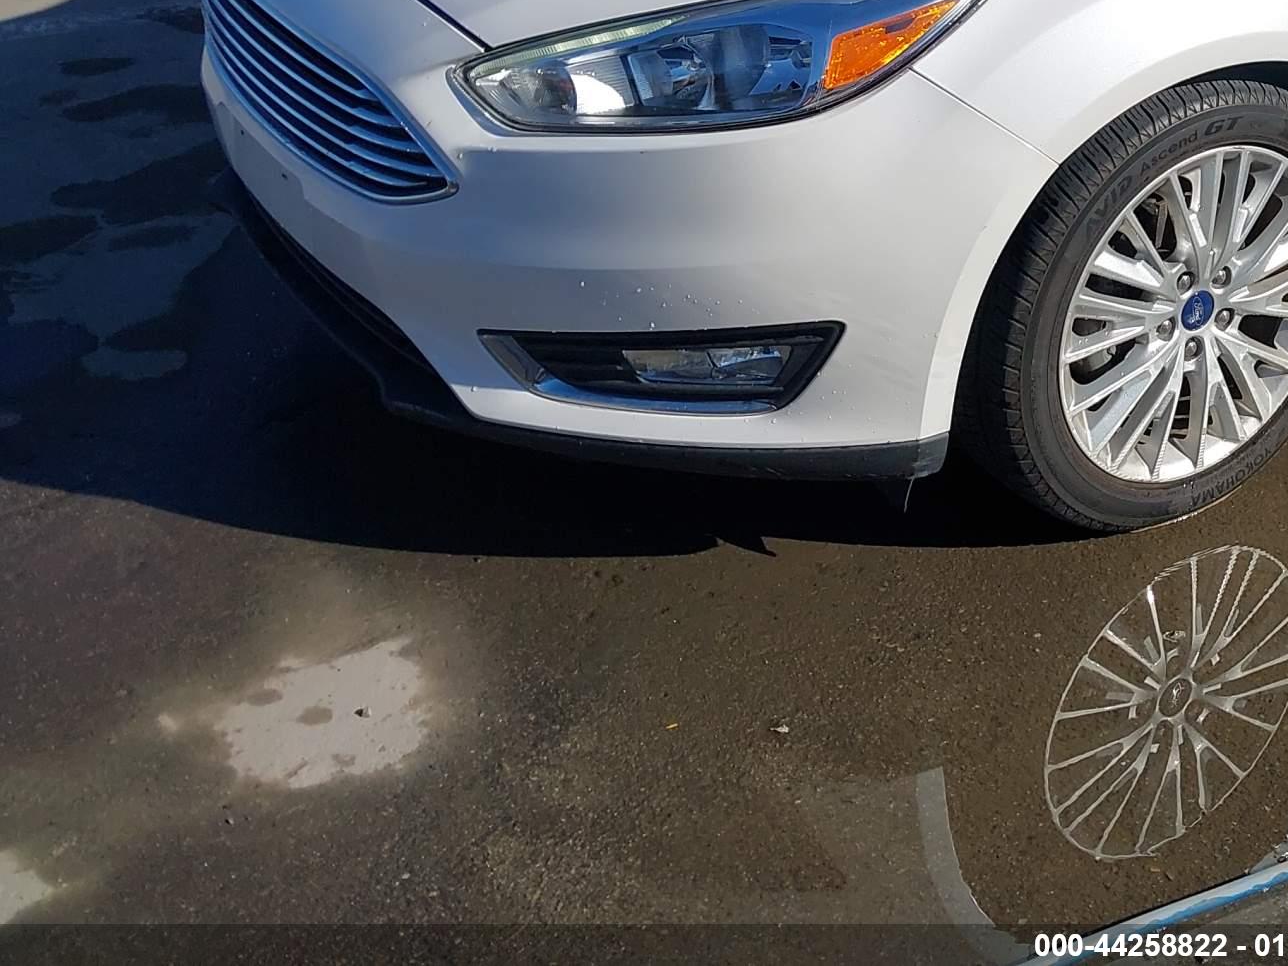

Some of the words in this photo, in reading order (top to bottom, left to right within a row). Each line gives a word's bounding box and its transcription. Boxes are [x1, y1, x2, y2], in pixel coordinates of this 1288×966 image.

[1138, 129, 1199, 177] Ascend
[1204, 116, 1244, 136] GT
[1190, 448, 1272, 506] YOKOHAMA
